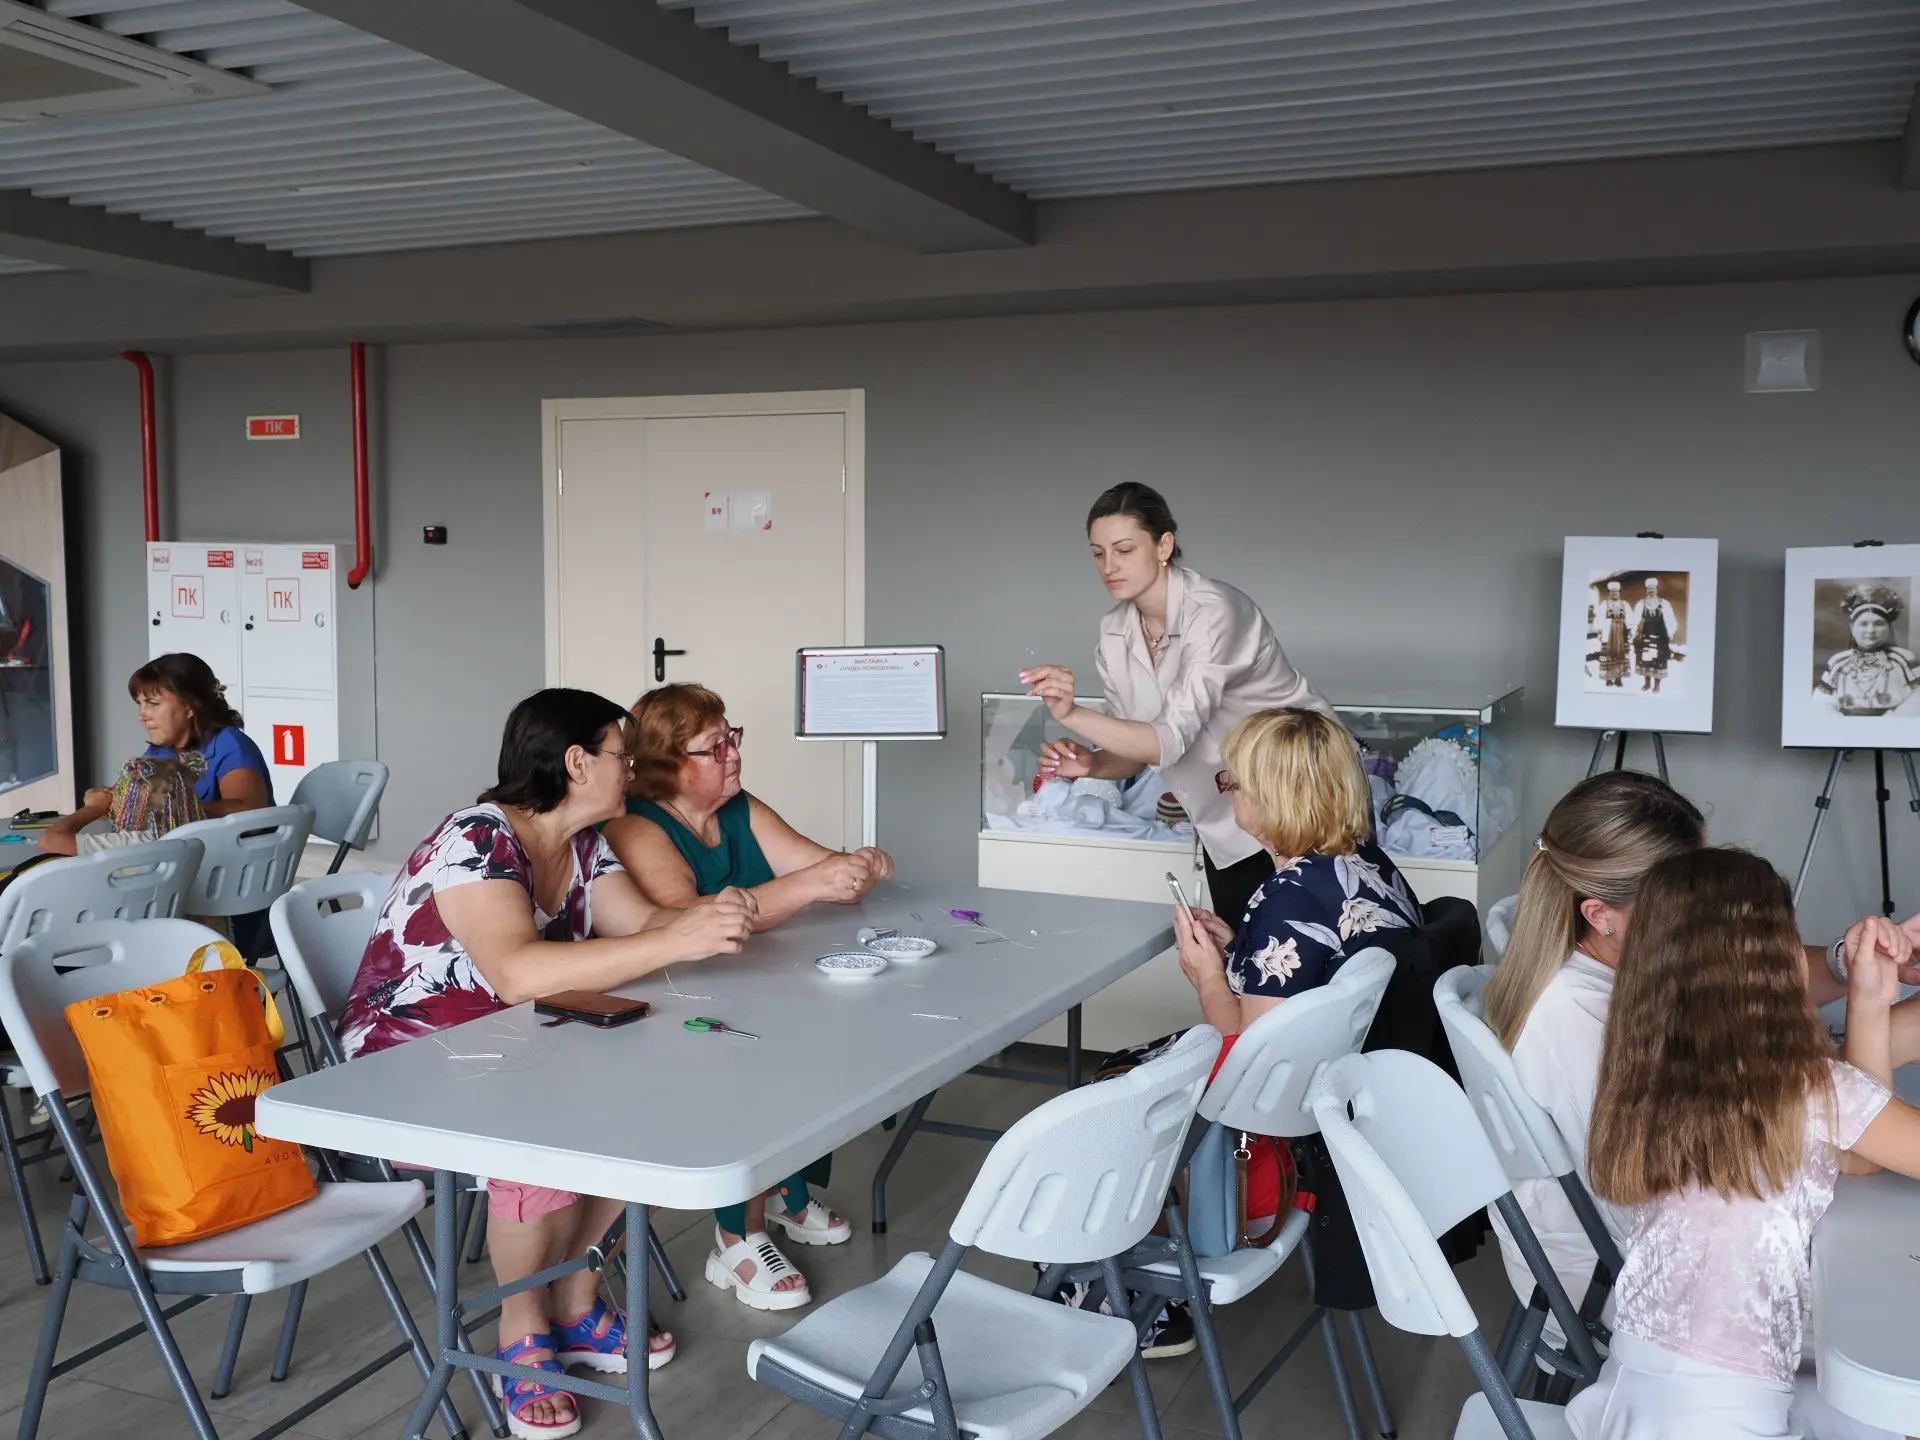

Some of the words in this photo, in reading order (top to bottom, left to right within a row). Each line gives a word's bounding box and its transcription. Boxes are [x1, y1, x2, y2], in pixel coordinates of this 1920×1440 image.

[264, 420, 284, 433] ПК
[178, 587, 197, 605] ПК
[273, 591, 293, 609] ПК
[264, 1149, 300, 1166] AVON
